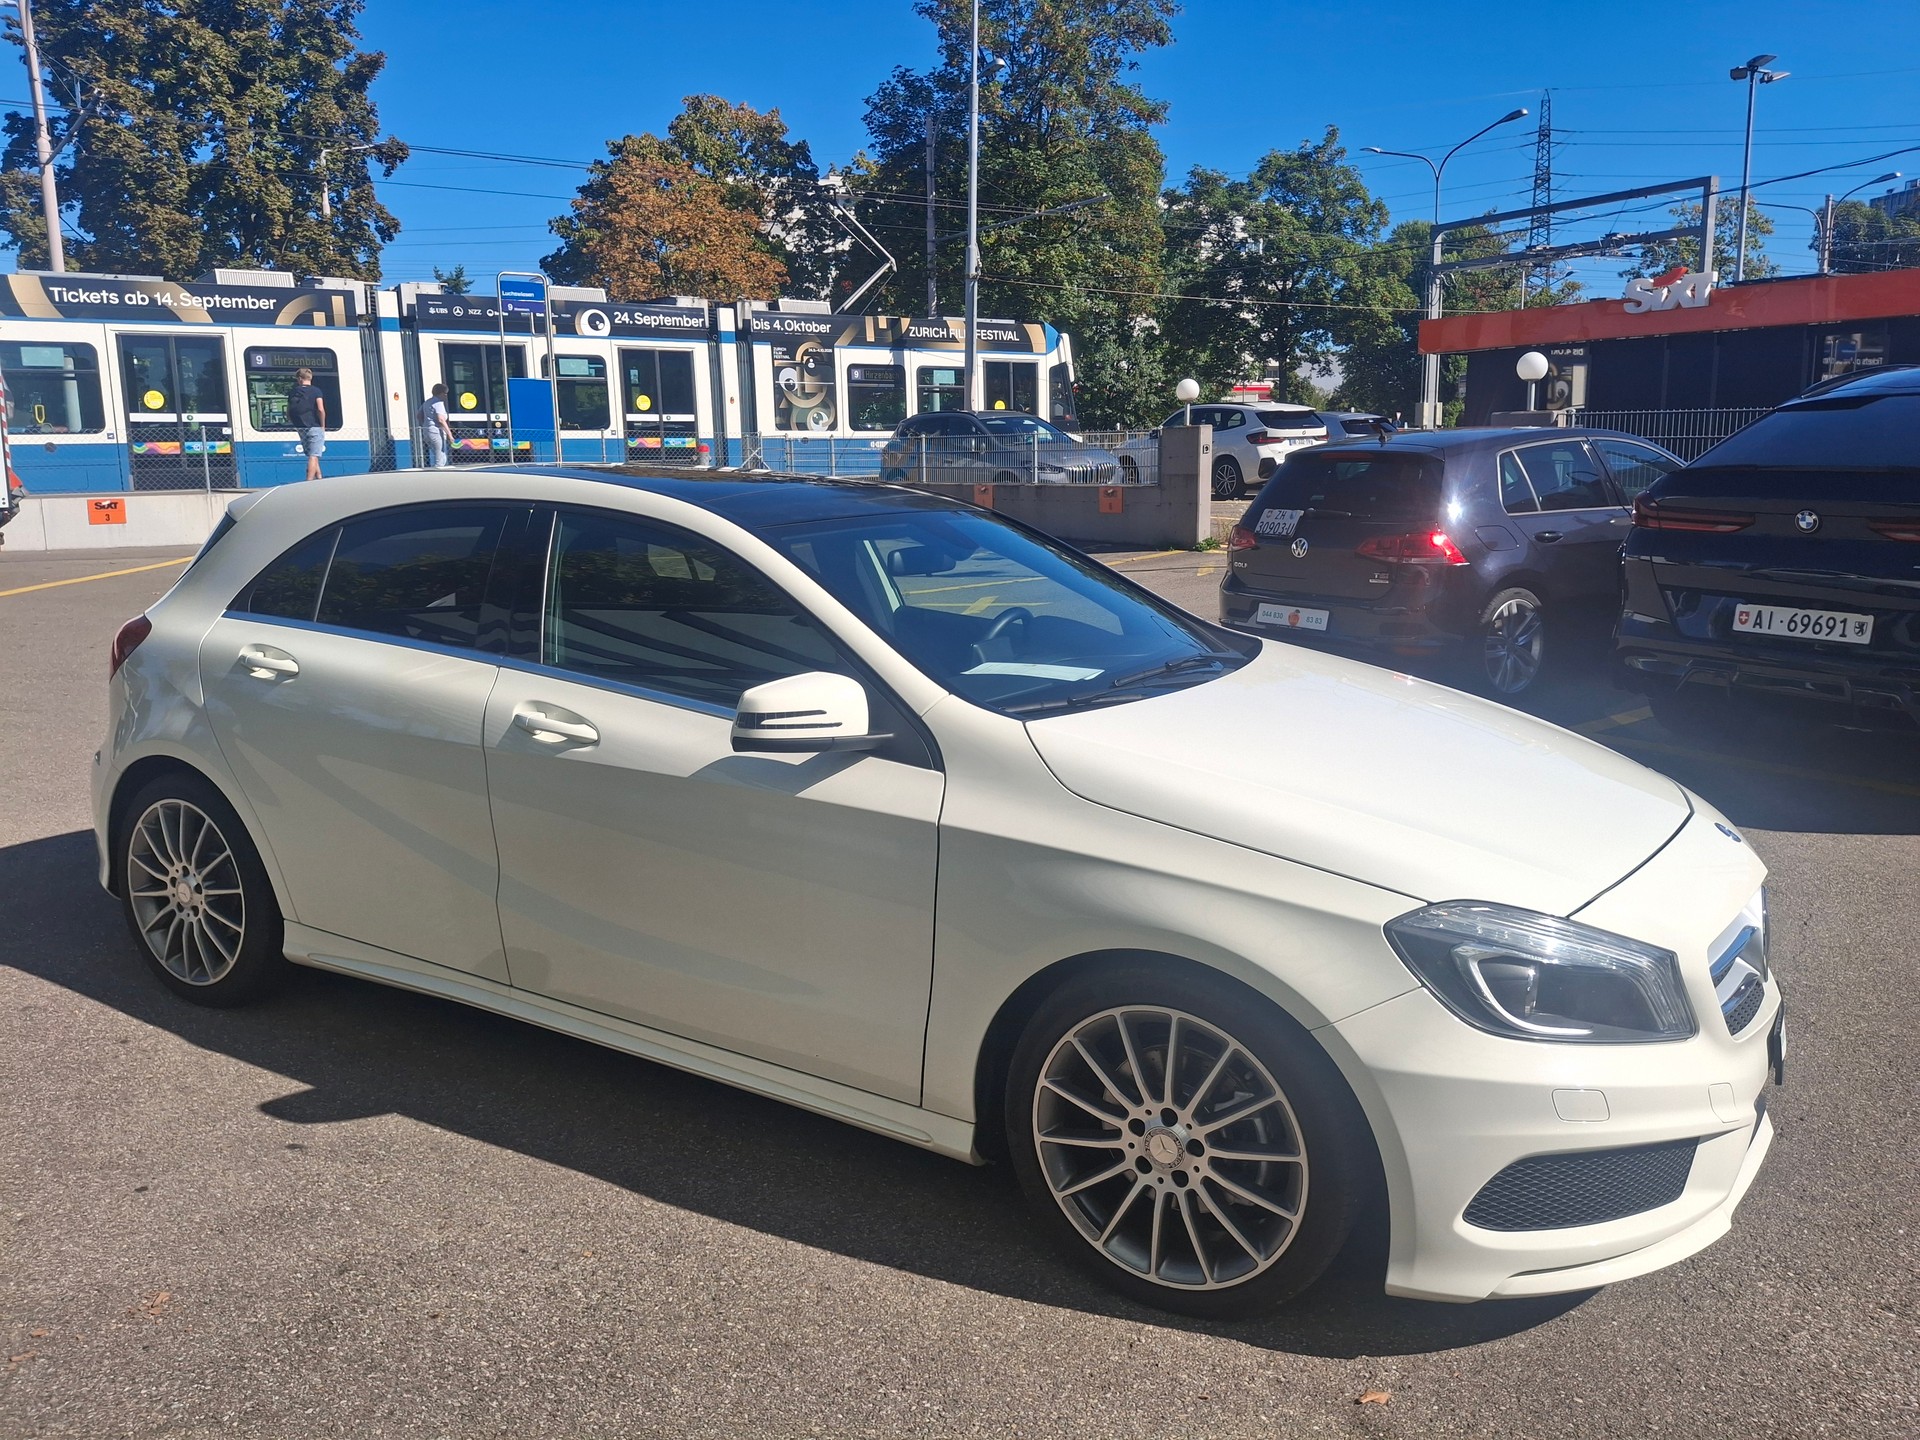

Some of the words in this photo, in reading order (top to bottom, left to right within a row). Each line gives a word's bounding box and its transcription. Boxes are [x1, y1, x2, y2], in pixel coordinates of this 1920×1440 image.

[49, 286, 119, 305] Tickets
[124, 290, 149, 306] ab
[156, 292, 177, 307] 14.
[180, 292, 276, 311] September
[507, 303, 514, 311] 9
[613, 311, 633, 325] 24.
[634, 312, 704, 328] September
[753, 318, 770, 330] bis
[773, 319, 784, 331] 4.
[785, 320, 831, 333] Oktober
[909, 326, 947, 338] ZURICH
[950, 329, 966, 339] FIL
[976, 330, 1020, 341] FESTIVAL
[255, 355, 264, 365] 9
[274, 355, 328, 366] Hirzenbach
[853, 370, 859, 379] 9
[1275, 510, 1287, 520] ZH
